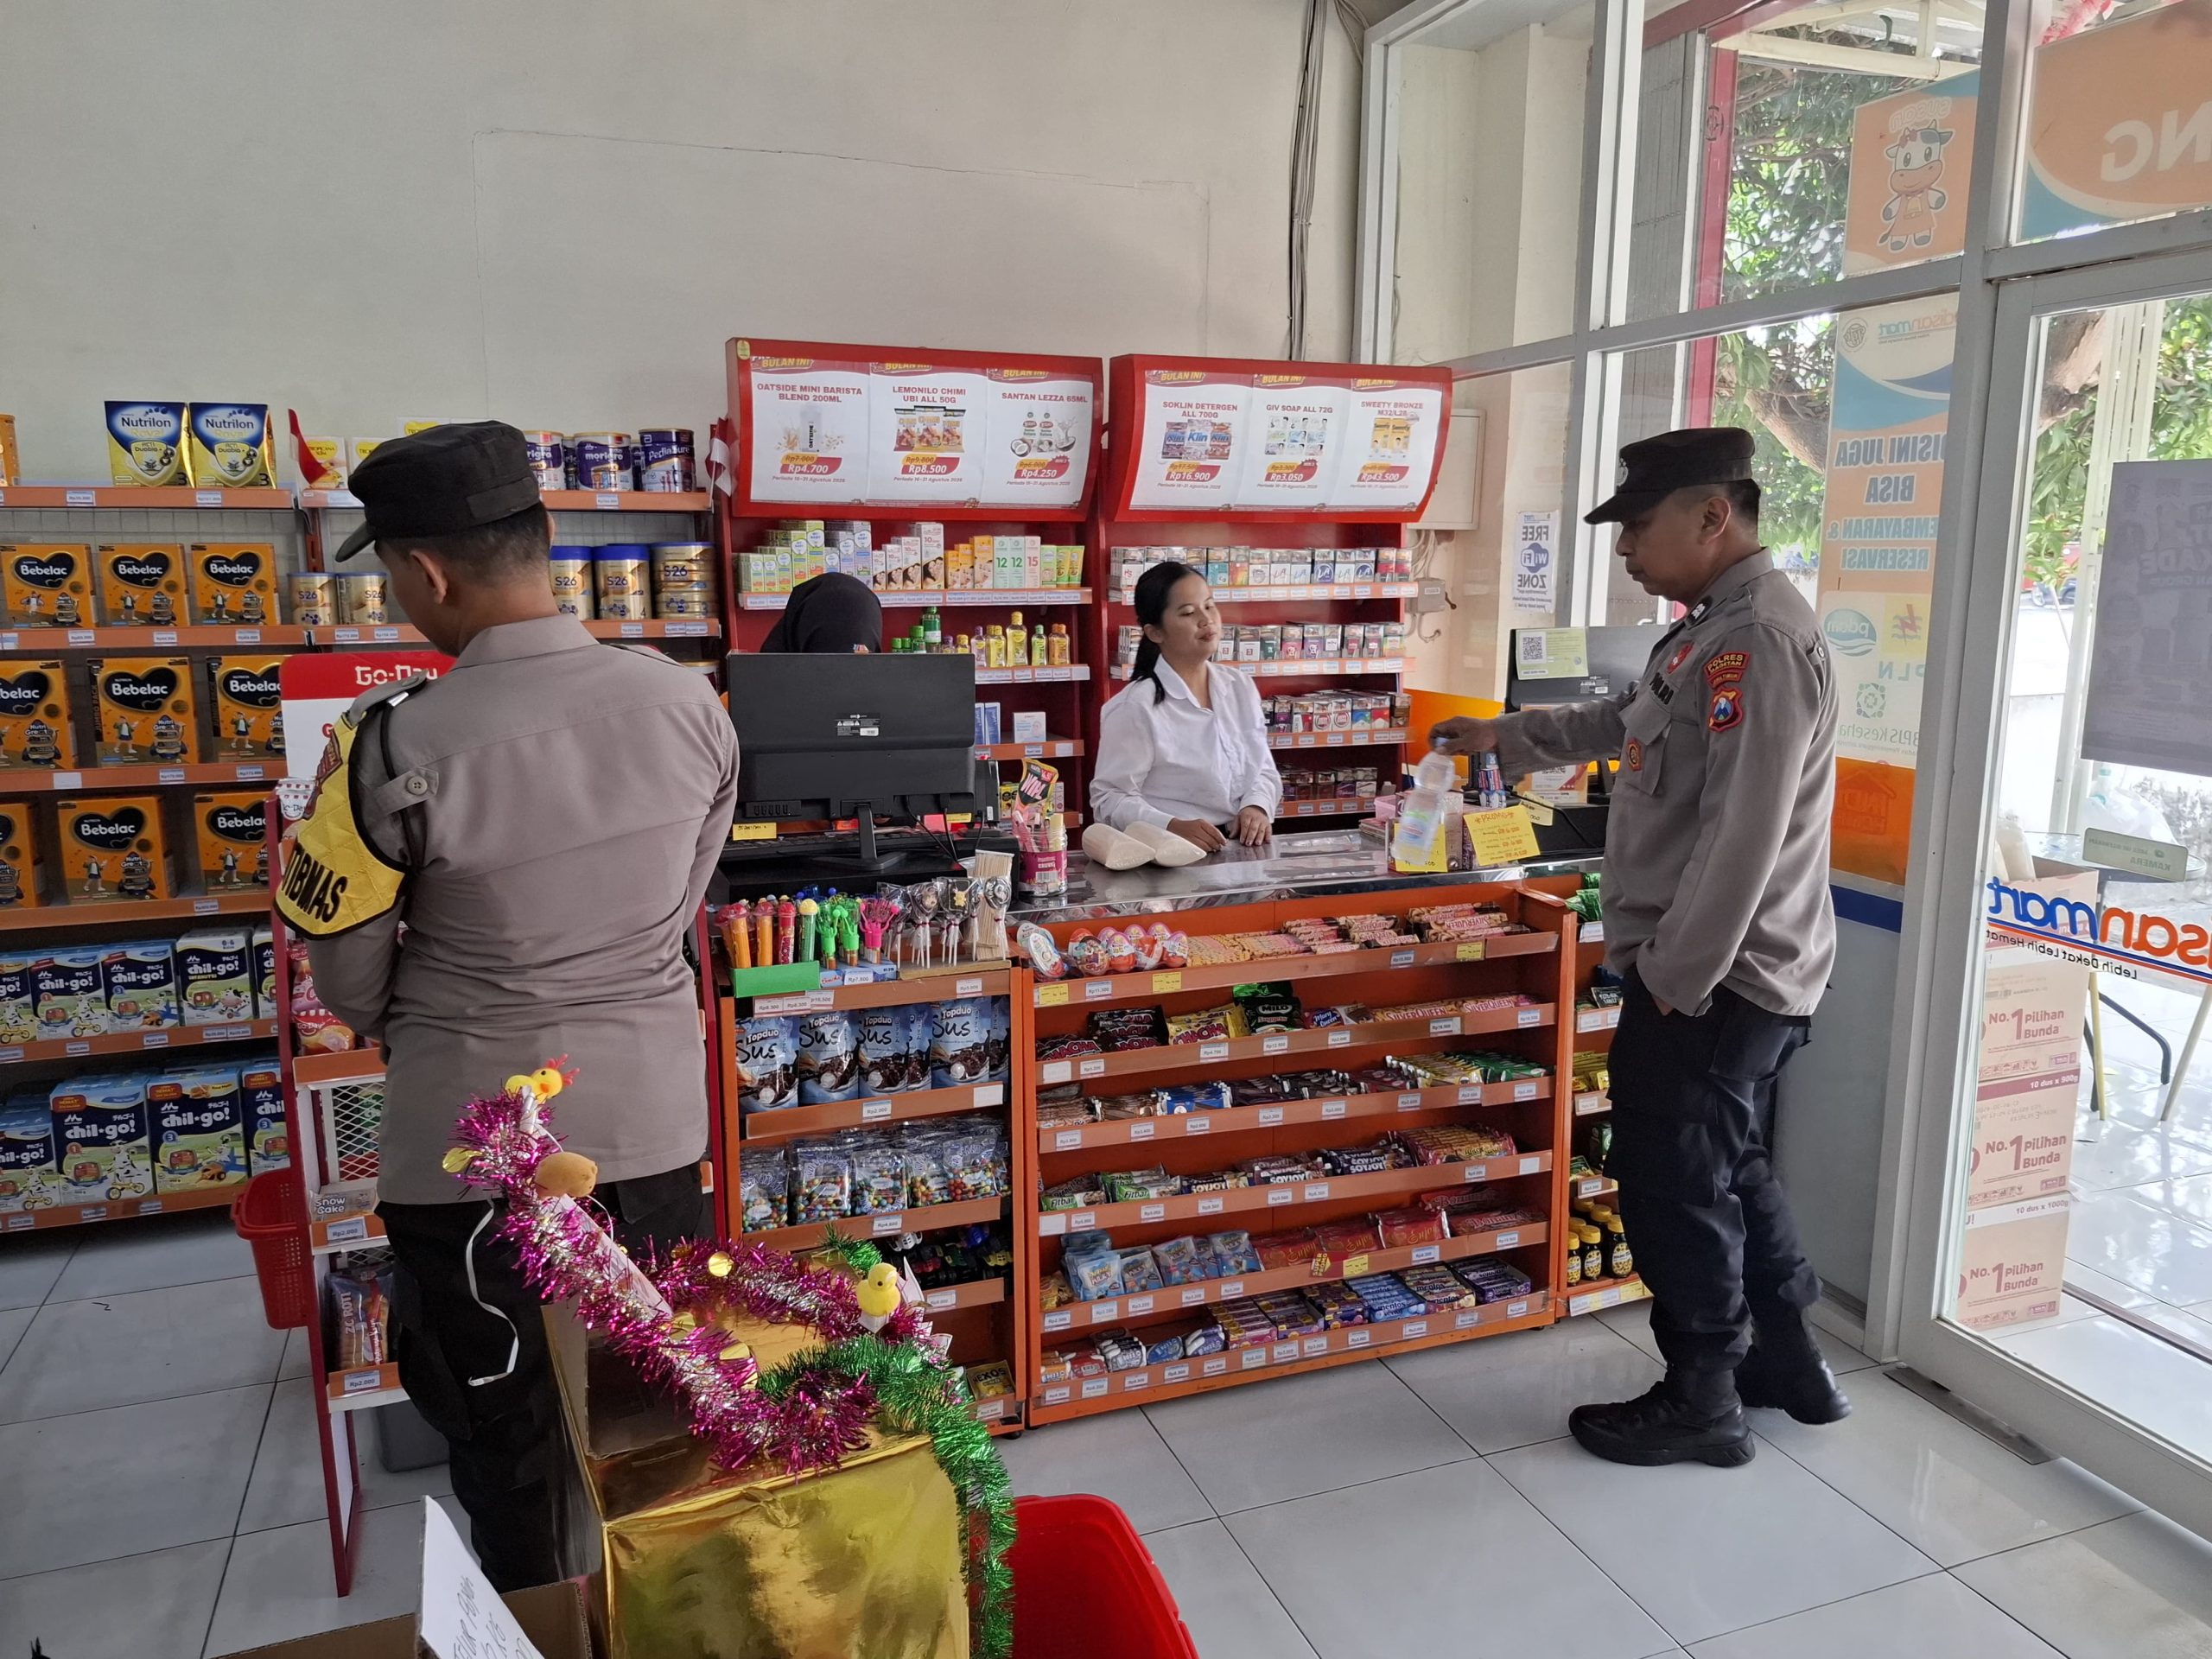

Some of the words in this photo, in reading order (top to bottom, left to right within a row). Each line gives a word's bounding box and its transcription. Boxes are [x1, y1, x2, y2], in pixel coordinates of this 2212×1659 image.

[761, 358, 794, 368] BULAN
[1192, 372, 1204, 380] INI
[757, 383, 798, 392] OATSIDE
[823, 386, 862, 395] BARISTA
[893, 386, 938, 395] LEMONILO
[779, 392, 810, 401] BLEND
[813, 394, 842, 403] 200ML
[121, 417, 171, 429] Nutrilon
[206, 418, 254, 429] Nutrilon
[1187, 432, 1208, 442] Klin
[527, 450, 552, 461] rigro
[585, 451, 623, 461] morigro
[787, 465, 829, 475] Rp4.700
[908, 465, 947, 475] Rp8.500
[1020, 469, 1058, 480] Rp4.250
[178, 472, 188, 486] 3
[261, 472, 270, 486] 3
[1169, 472, 1211, 481] Rp16.900
[1270, 473, 1304, 482] Rp3.050
[996, 556, 1007, 568] 12
[1012, 556, 1023, 568] 12
[1027, 556, 1039, 567] 15
[21, 564, 67, 575] Bebelac
[118, 563, 163, 575] Bebelac
[210, 563, 253, 575] Bebelac
[664, 565, 688, 577] S-26
[555, 576, 577, 587] S-26
[607, 576, 628, 586] S-26
[1707, 654, 1744, 671] POLRES
[355, 664, 438, 686] Go-Dy
[0, 687, 40, 700] belac
[111, 683, 168, 696] Bebelac
[81, 822, 136, 836] Bebelac
[1261, 1003, 1293, 1014] MILO
[1463, 997, 1514, 1013] SILVERQUEEN
[942, 1006, 972, 1020] Topduo
[1313, 1008, 1332, 1022] Mary
[1384, 1007, 1446, 1022] SILVERQUEEN
[810, 1014, 840, 1028] Topduo
[865, 1016, 893, 1026] Topduo
[932, 1014, 970, 1038] Sus
[1989, 1011, 2010, 1024] No.
[2011, 1007, 2024, 1040] 1
[2024, 1008, 2064, 1025] Pilihan
[748, 1028, 779, 1044] Topduo
[799, 1024, 840, 1047] Sus
[2024, 1024, 2059, 1039] Bunda
[736, 1039, 777, 1064] Sus
[2040, 1078, 2052, 1088] dus
[2062, 1075, 2079, 1085] 900g
[1986, 1140, 2008, 1155] No.
[2009, 1135, 2023, 1171] 1
[2024, 1135, 2067, 1151] Pilihan
[2023, 1151, 2061, 1169] Bunda
[1350, 1160, 1386, 1173] SOYJOY
[1269, 1171, 1306, 1184] SOYJOY
[1191, 1181, 1227, 1193] SOYJOY
[1124, 1190, 1148, 1199] Fitbar
[315, 1197, 346, 1206] Snow
[1051, 1196, 1076, 1207] Fitbar
[2016, 1206, 2024, 1215] 10
[2026, 1205, 2039, 1214] dus
[2047, 1199, 2069, 1211] 1000g
[316, 1205, 345, 1215] Cake
[332, 1228, 359, 1238] Rp2.000
[1311, 1252, 1321, 1278] SUPER
[1319, 1251, 1329, 1277] PROMO
[1970, 1267, 1991, 1281] No.
[1992, 1262, 2005, 1294] 1
[2005, 1261, 2044, 1276] Pilihan
[2004, 1275, 2038, 1292] Bunda
[1377, 1301, 1406, 1312] mentos
[349, 1377, 376, 1387] Rp2.000
